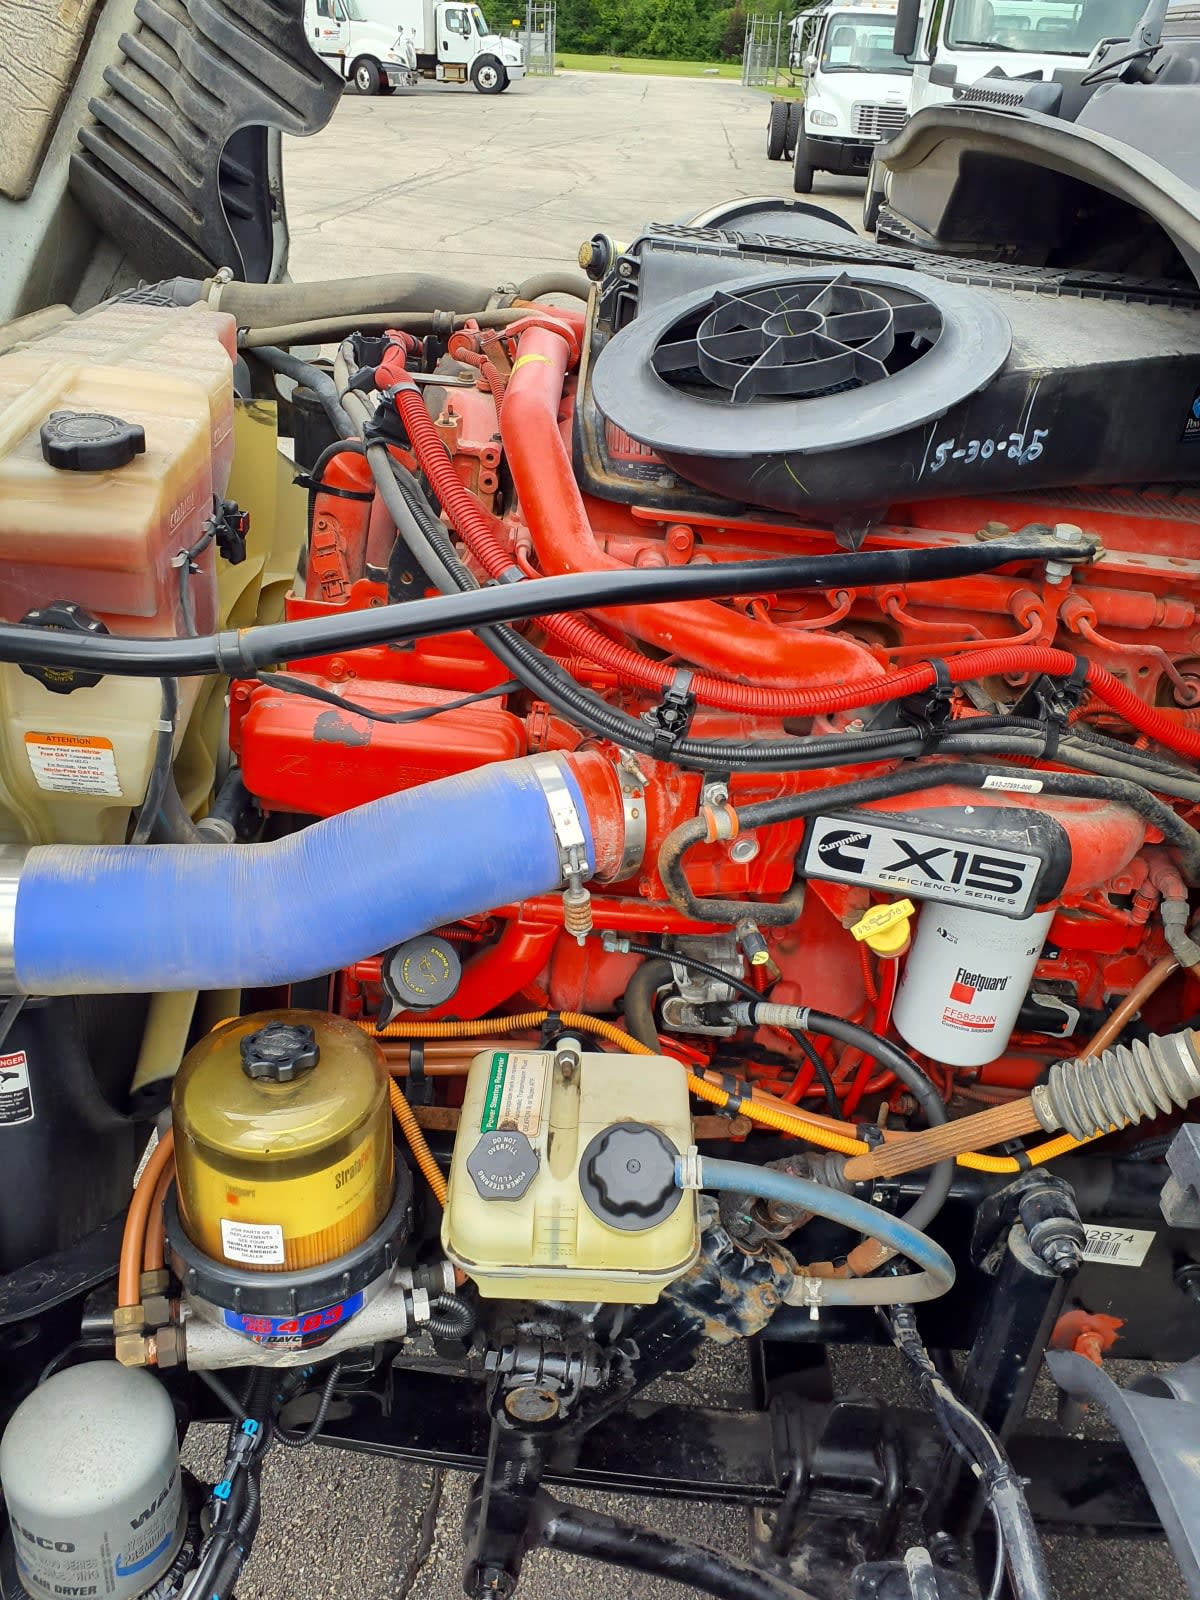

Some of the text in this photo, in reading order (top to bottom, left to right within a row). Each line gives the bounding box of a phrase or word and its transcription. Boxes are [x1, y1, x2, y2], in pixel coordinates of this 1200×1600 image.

[46, 735, 91, 745] ATTENTION
[819, 832, 868, 852] Cummins
[882, 838, 1027, 895] X15
[878, 872, 1017, 905] EFFICIENCY SERIES
[955, 967, 1009, 992] Fleetguard
[943, 1006, 998, 1023] FF5825NN
[486, 1057, 505, 1128] Power Steering Reservoir
[488, 1143, 518, 1156] OVERFILL
[492, 1136, 517, 1145] DO NOT
[477, 1169, 527, 1190] POWER STEERING
[490, 1174, 513, 1183] FLUID
[276, 1305, 344, 1333] 483
[32, 1574, 51, 1591] AIR
[54, 1585, 97, 1596] DRYER
